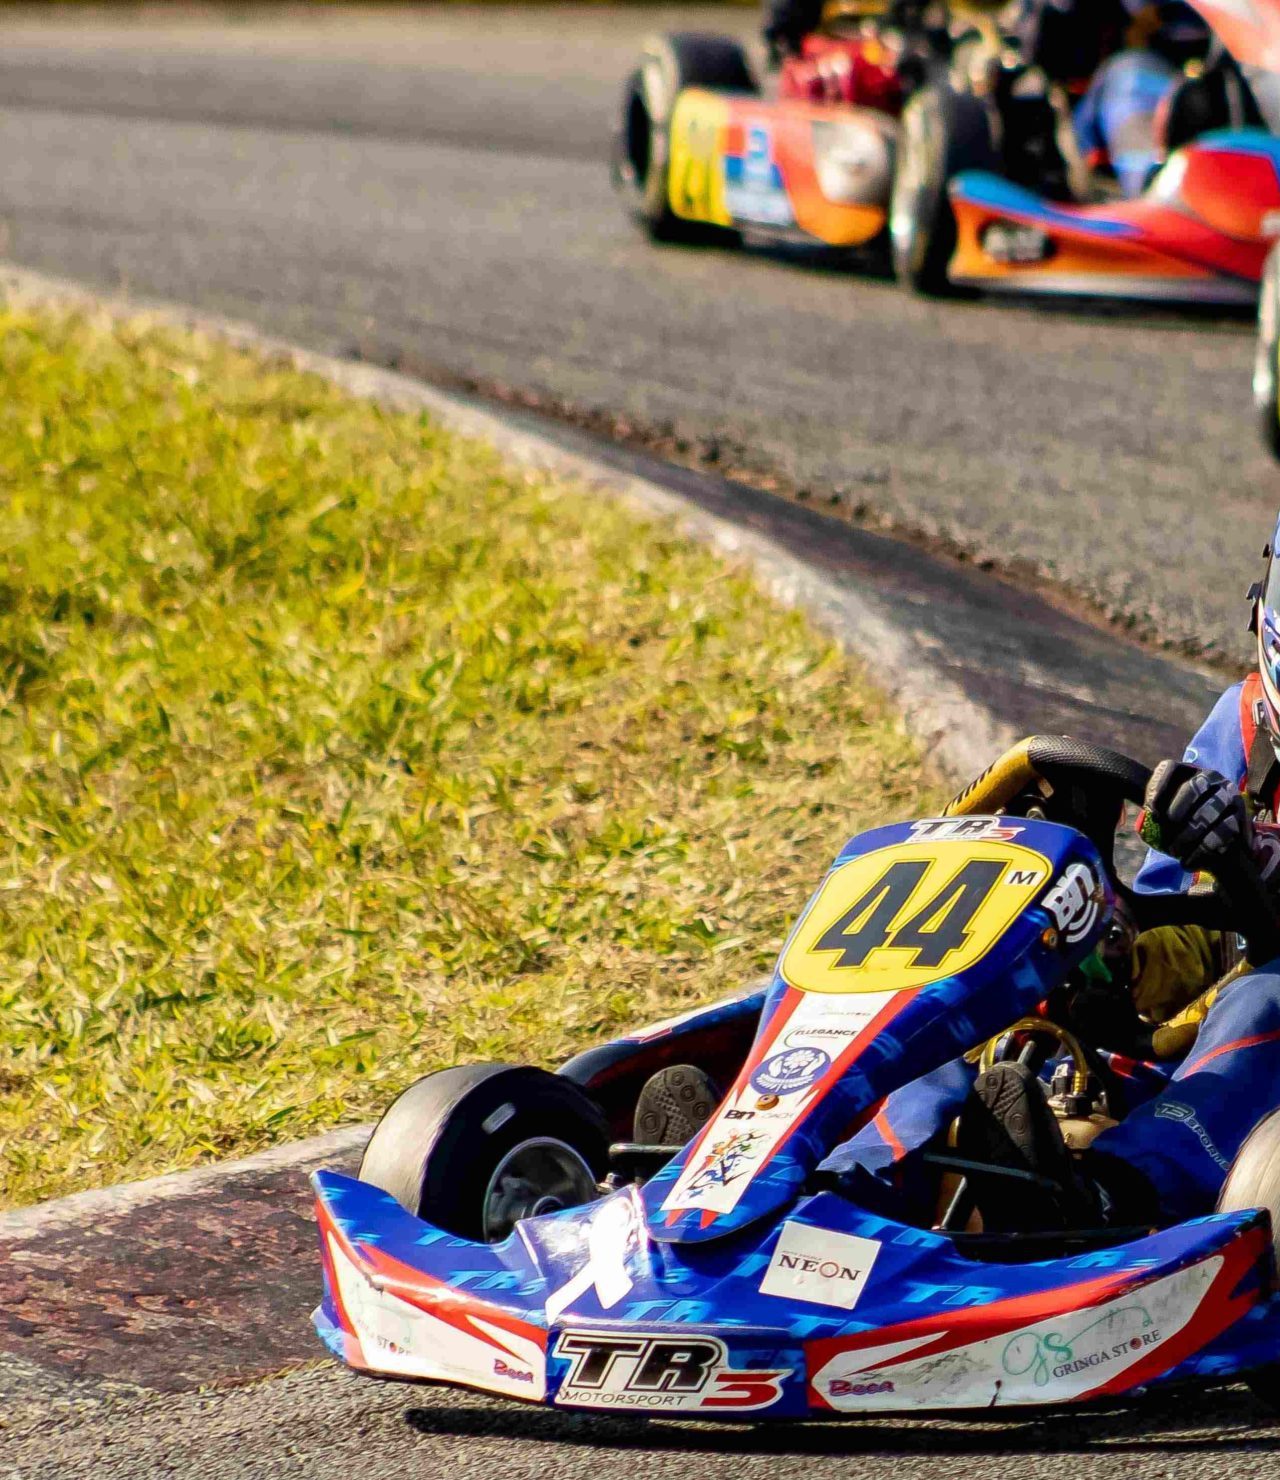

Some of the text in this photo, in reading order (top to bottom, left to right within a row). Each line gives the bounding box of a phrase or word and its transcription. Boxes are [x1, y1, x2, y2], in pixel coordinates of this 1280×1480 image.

[809, 859, 1037, 969] 44 M
[777, 1254, 861, 1281] NEON
[1052, 1329, 1162, 1379] GRINGA STORE
[564, 1390, 688, 1406] MOTORSPORT
